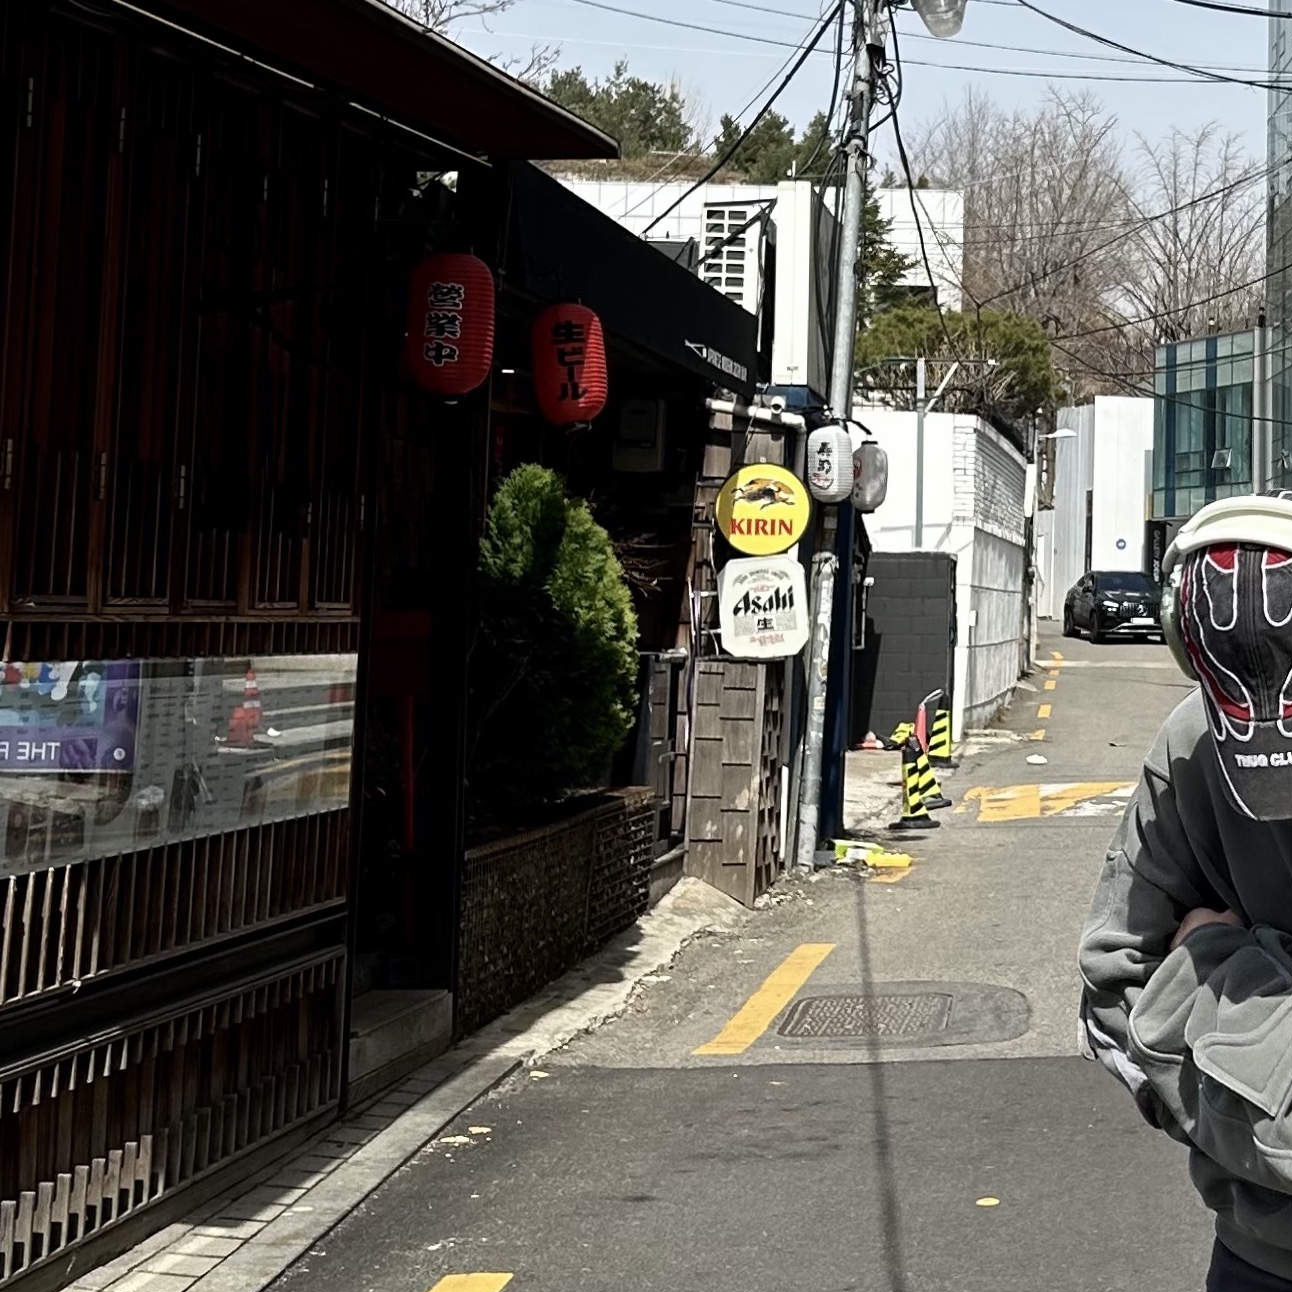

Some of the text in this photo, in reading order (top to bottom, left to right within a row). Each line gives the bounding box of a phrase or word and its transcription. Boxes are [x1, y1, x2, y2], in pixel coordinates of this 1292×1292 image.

[552, 320, 588, 401] 生ビール
[730, 518, 793, 536] KIRIN
[733, 585, 795, 617] Asahi
